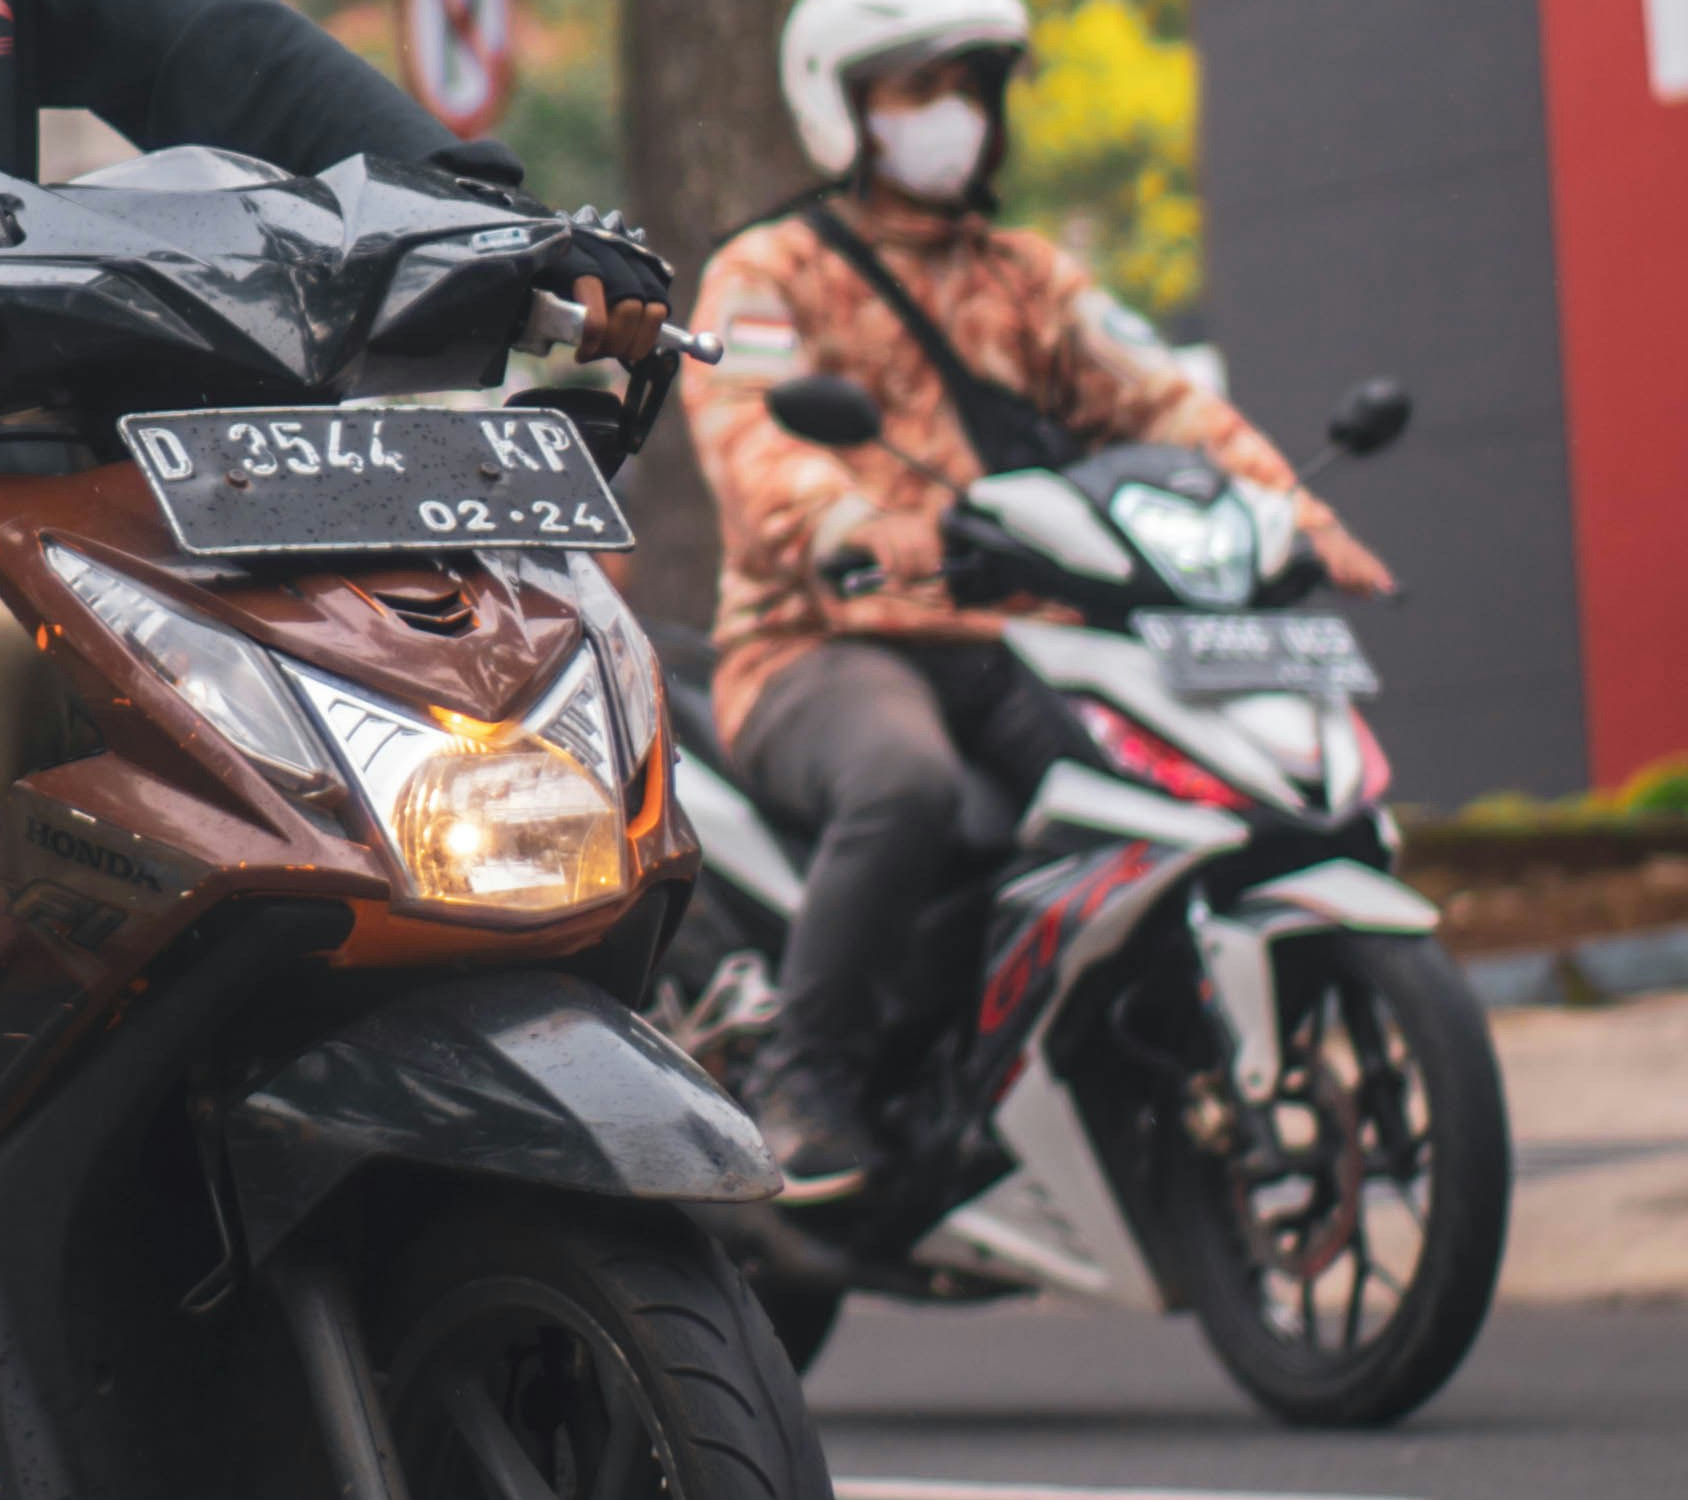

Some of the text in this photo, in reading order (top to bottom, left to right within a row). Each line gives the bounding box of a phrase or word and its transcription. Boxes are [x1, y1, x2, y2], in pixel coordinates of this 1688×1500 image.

[138, 419, 571, 480] D 3544 KP
[26, 816, 162, 893] HONDA
